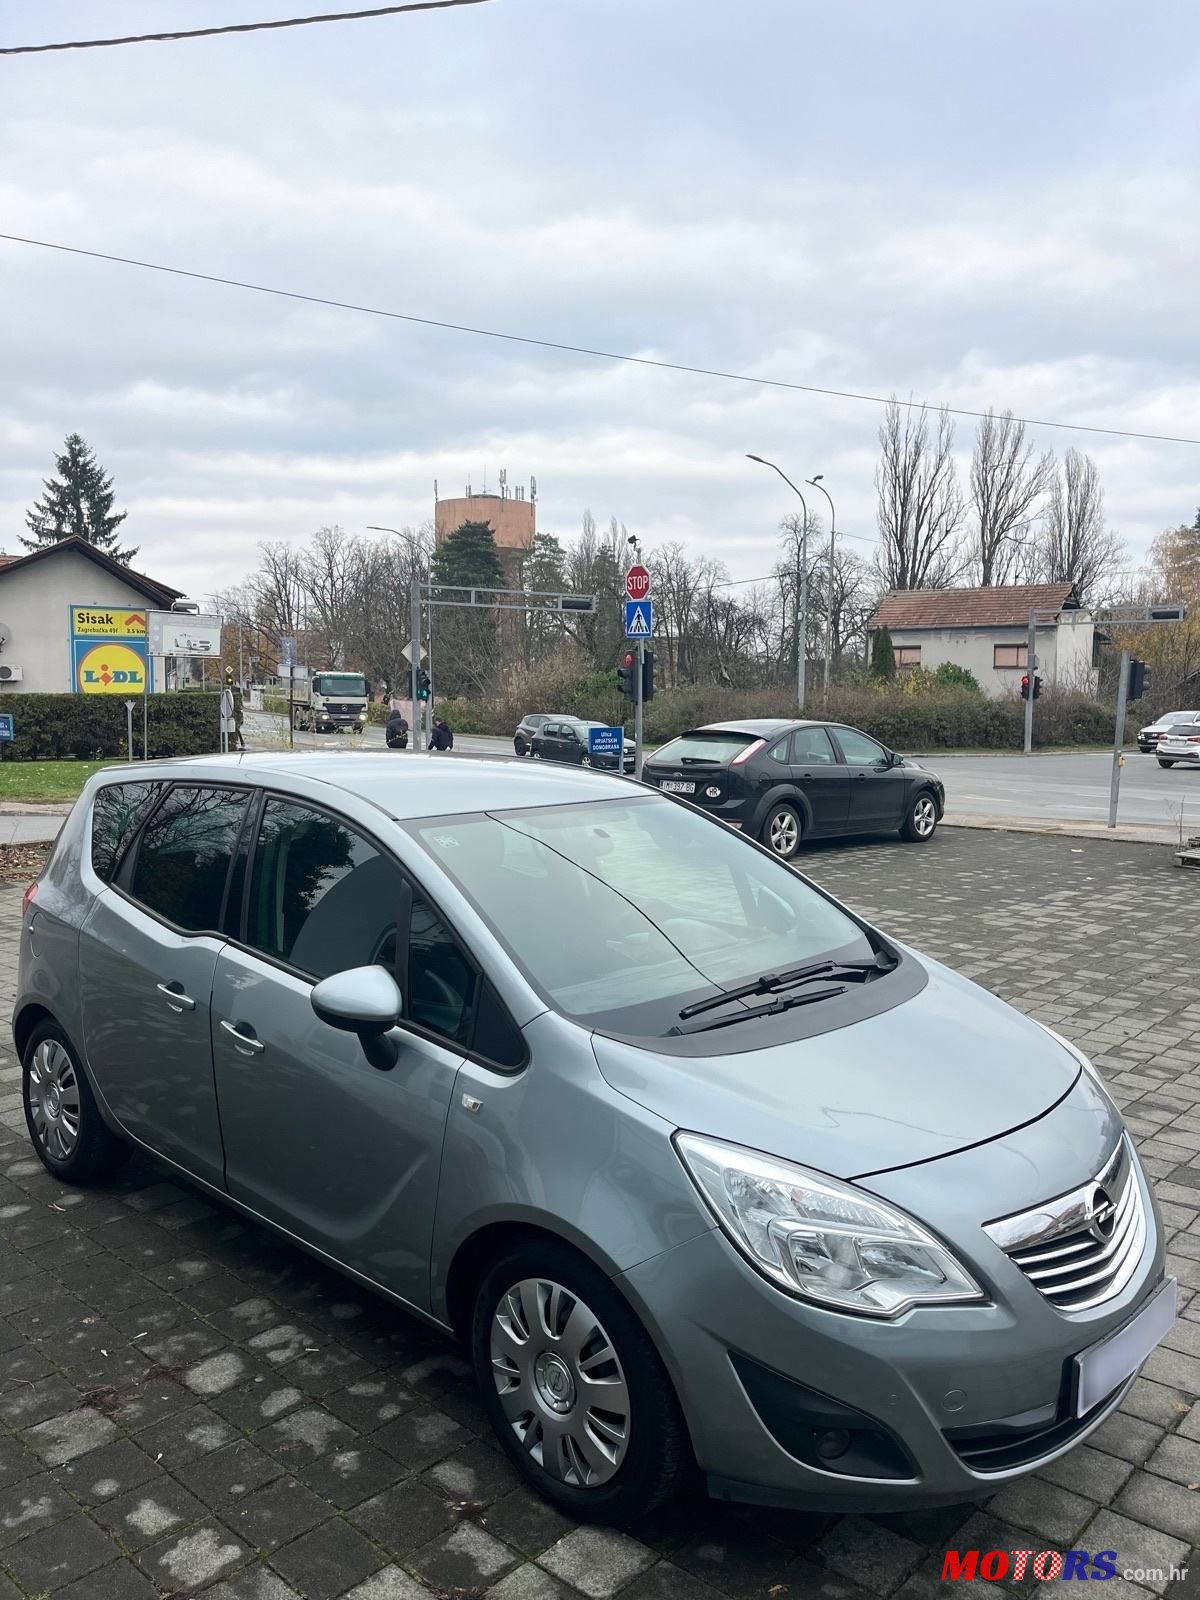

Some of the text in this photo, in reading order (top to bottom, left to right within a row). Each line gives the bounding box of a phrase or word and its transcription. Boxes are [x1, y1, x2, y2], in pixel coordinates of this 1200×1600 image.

[627, 575, 648, 590] STOP
[77, 612, 114, 625] Sisak
[709, 787, 718, 796] HR
